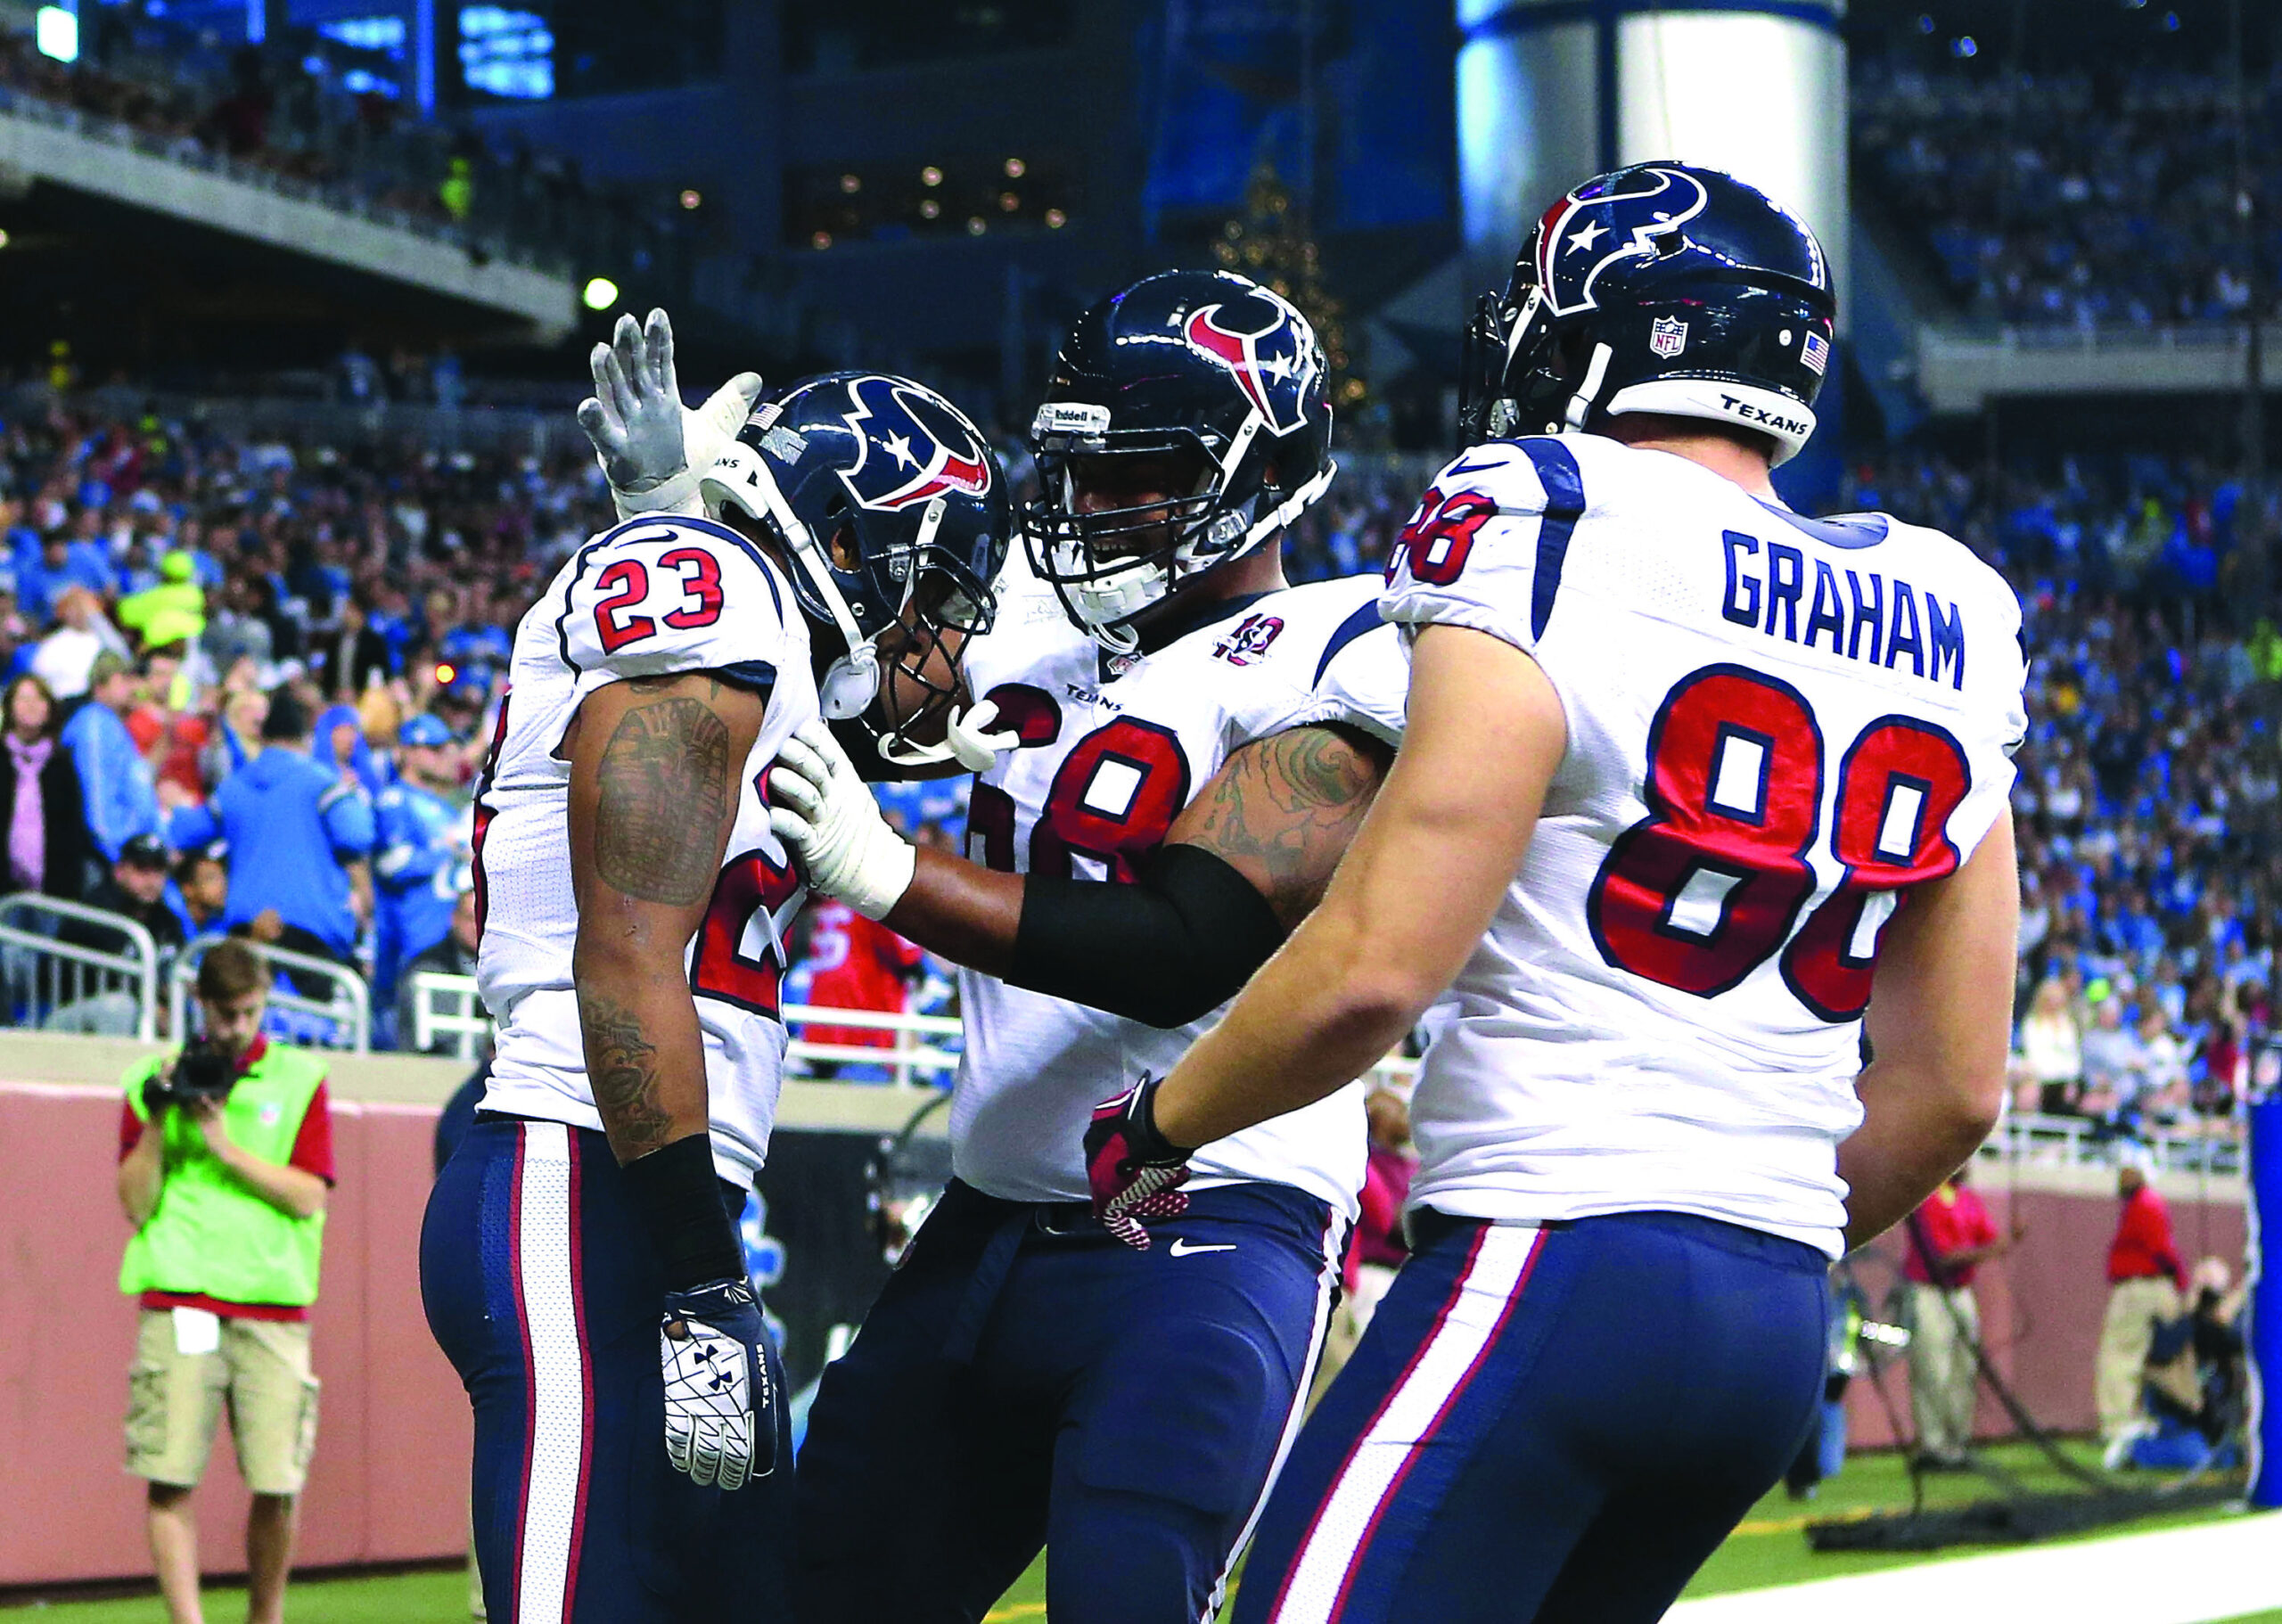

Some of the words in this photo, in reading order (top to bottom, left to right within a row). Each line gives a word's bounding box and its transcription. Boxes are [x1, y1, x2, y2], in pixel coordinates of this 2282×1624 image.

[1654, 333, 1680, 351] NFL
[1055, 409, 1088, 422] Riddell
[1720, 393, 1809, 435] TEXANS
[1384, 486, 1499, 587] 88
[594, 546, 726, 656] 23
[1722, 529, 1965, 692] GRAHAM
[1586, 661, 1973, 1024] 88
[756, 1343, 769, 1409] TEXANS
